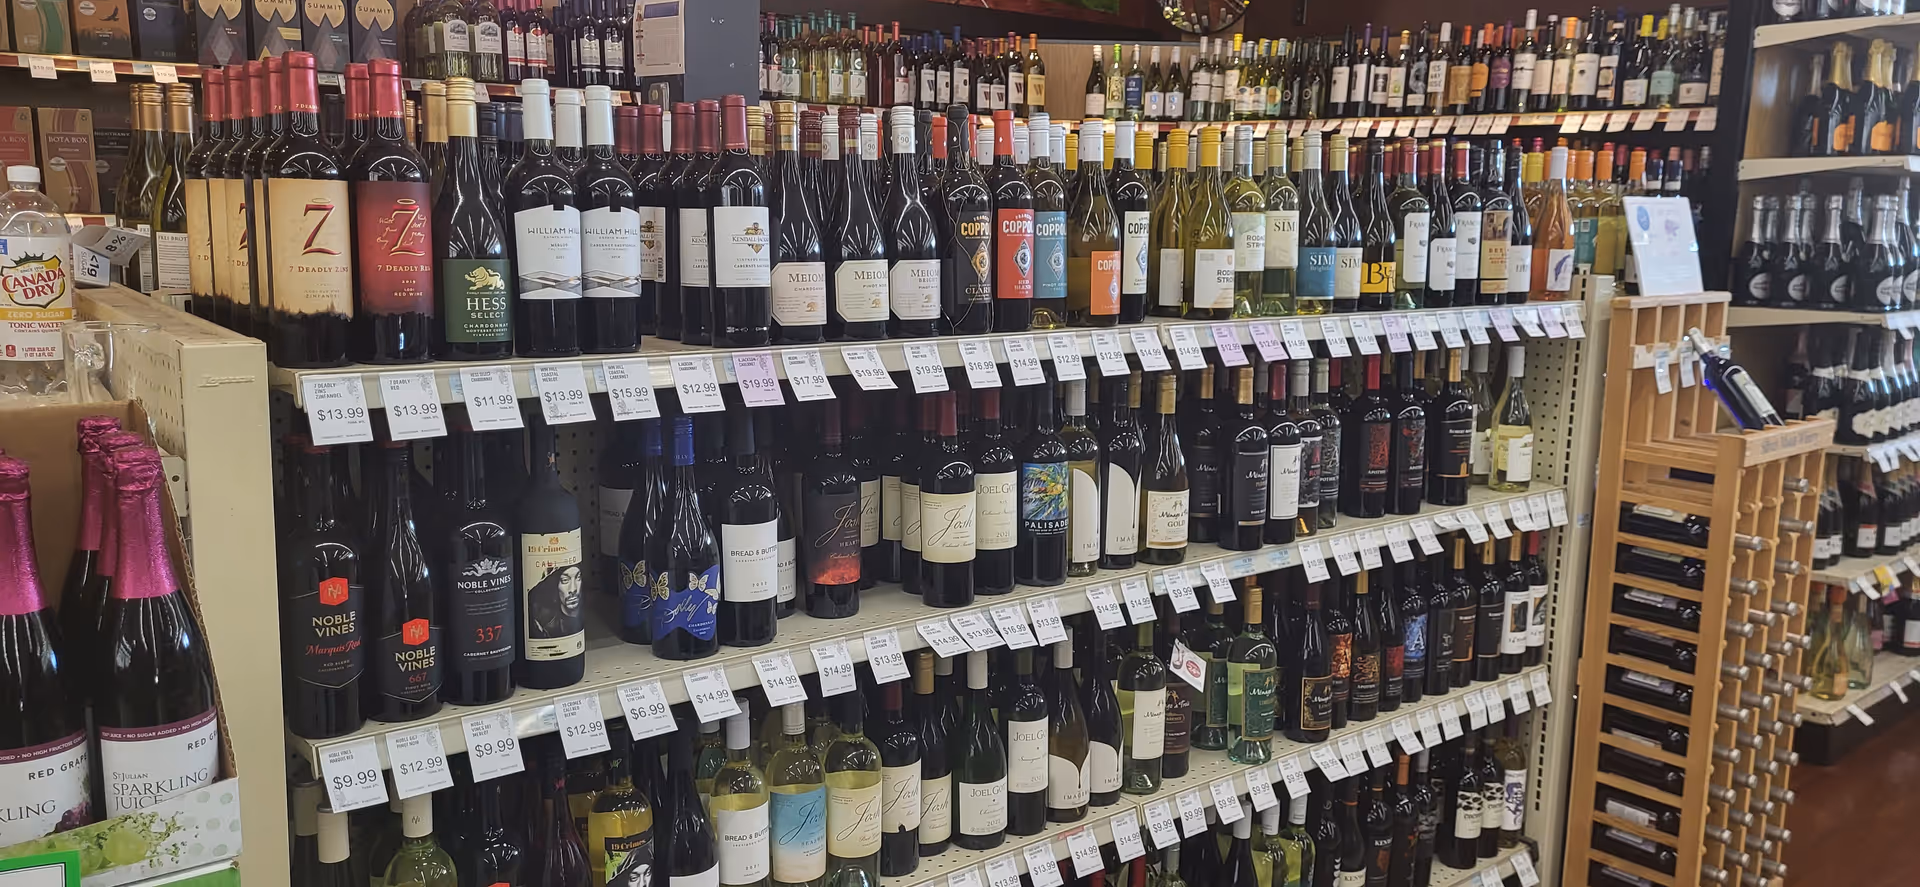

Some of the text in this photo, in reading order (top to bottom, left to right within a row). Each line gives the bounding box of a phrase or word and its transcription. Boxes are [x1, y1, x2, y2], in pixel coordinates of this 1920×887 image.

[307, 2, 342, 10] SUMMIT
[358, 6, 391, 14] SUMMIT
[48, 136, 88, 144] BOTA BOX
[527, 227, 566, 235] WILLIAM
[585, 228, 622, 236] WILLIAM
[105, 234, 127, 252] 8%
[289, 265, 333, 273] 7 DEADLY
[386, 264, 419, 272] DEADLY
[1, 267, 67, 294] CANADA
[23, 281, 57, 299] DRY
[466, 297, 507, 311] HESS
[7, 311, 33, 319] ZERO
[470, 311, 505, 319] SELECT
[1221, 343, 1241, 352] $12.99
[1259, 340, 1279, 348] $12.99
[1287, 340, 1306, 348] $14.99
[1099, 351, 1123, 360] $12.99
[1140, 348, 1162, 357] $14.99
[1179, 347, 1200, 355] $14.99
[1013, 357, 1038, 368] $14.99
[1057, 355, 1080, 364] $12.99
[916, 365, 943, 375] $19.99
[968, 361, 994, 371] $16.99
[855, 368, 885, 378] $19.99
[742, 378, 775, 389] $19.99
[793, 375, 825, 386] $17.99
[612, 387, 649, 399] $15.99
[682, 382, 717, 394] $12.99
[473, 395, 513, 407] $11.99
[544, 390, 583, 403] $13.99
[317, 407, 364, 421] $13.99
[393, 403, 438, 417] $13.99
[977, 483, 1001, 495] JOEL
[927, 504, 976, 547] Josh
[528, 545, 569, 553] 19 Crimes
[730, 549, 754, 558] BREAD
[457, 575, 511, 590] NOBLE VINES
[1210, 577, 1229, 588] $9.99
[1172, 586, 1193, 598] $9.99
[1096, 603, 1119, 614] $14.99
[1130, 597, 1151, 608] $14.99
[312, 610, 357, 626] NOBLE
[1036, 616, 1060, 628] $13.99
[314, 622, 356, 638] VINES
[475, 624, 503, 643] 337
[966, 628, 994, 639] $13.99
[1002, 624, 1027, 635] $16.99
[932, 635, 960, 646] $14.99
[304, 642, 346, 657] Marquis
[395, 645, 436, 662] NOBLE
[463, 649, 489, 657] CABERNET
[398, 656, 435, 672] VINES
[874, 652, 902, 666] $13.99
[823, 663, 852, 677] $14.99
[408, 672, 427, 683] 667
[766, 675, 797, 688] $14.99
[696, 689, 729, 704] $14.99
[630, 702, 665, 720] $6.99
[157, 728, 178, 736] ADDED
[566, 721, 603, 738] $12.99
[1013, 732, 1036, 742] JOEL
[187, 737, 207, 751] RED
[475, 738, 515, 758] $9.99
[33, 749, 48, 757] HIGH
[28, 752, 88, 781] RED GRAPE
[400, 756, 443, 775] $12.99
[113, 767, 209, 797] SPARKLING
[121, 771, 149, 781] JULIAN
[333, 769, 377, 790] $9.99
[1286, 771, 1303, 784] $9.99
[970, 788, 992, 799] JOEL
[1252, 783, 1270, 796] $9.99
[1218, 796, 1236, 809] $9.99
[1184, 807, 1203, 821] $9.99
[1152, 819, 1173, 833] $9.99
[724, 834, 748, 842] BREAD
[1120, 832, 1141, 846] $14.99
[611, 838, 647, 851] 19 Crimes
[1075, 845, 1098, 860] $14.99
[1034, 861, 1056, 876] $13.99
